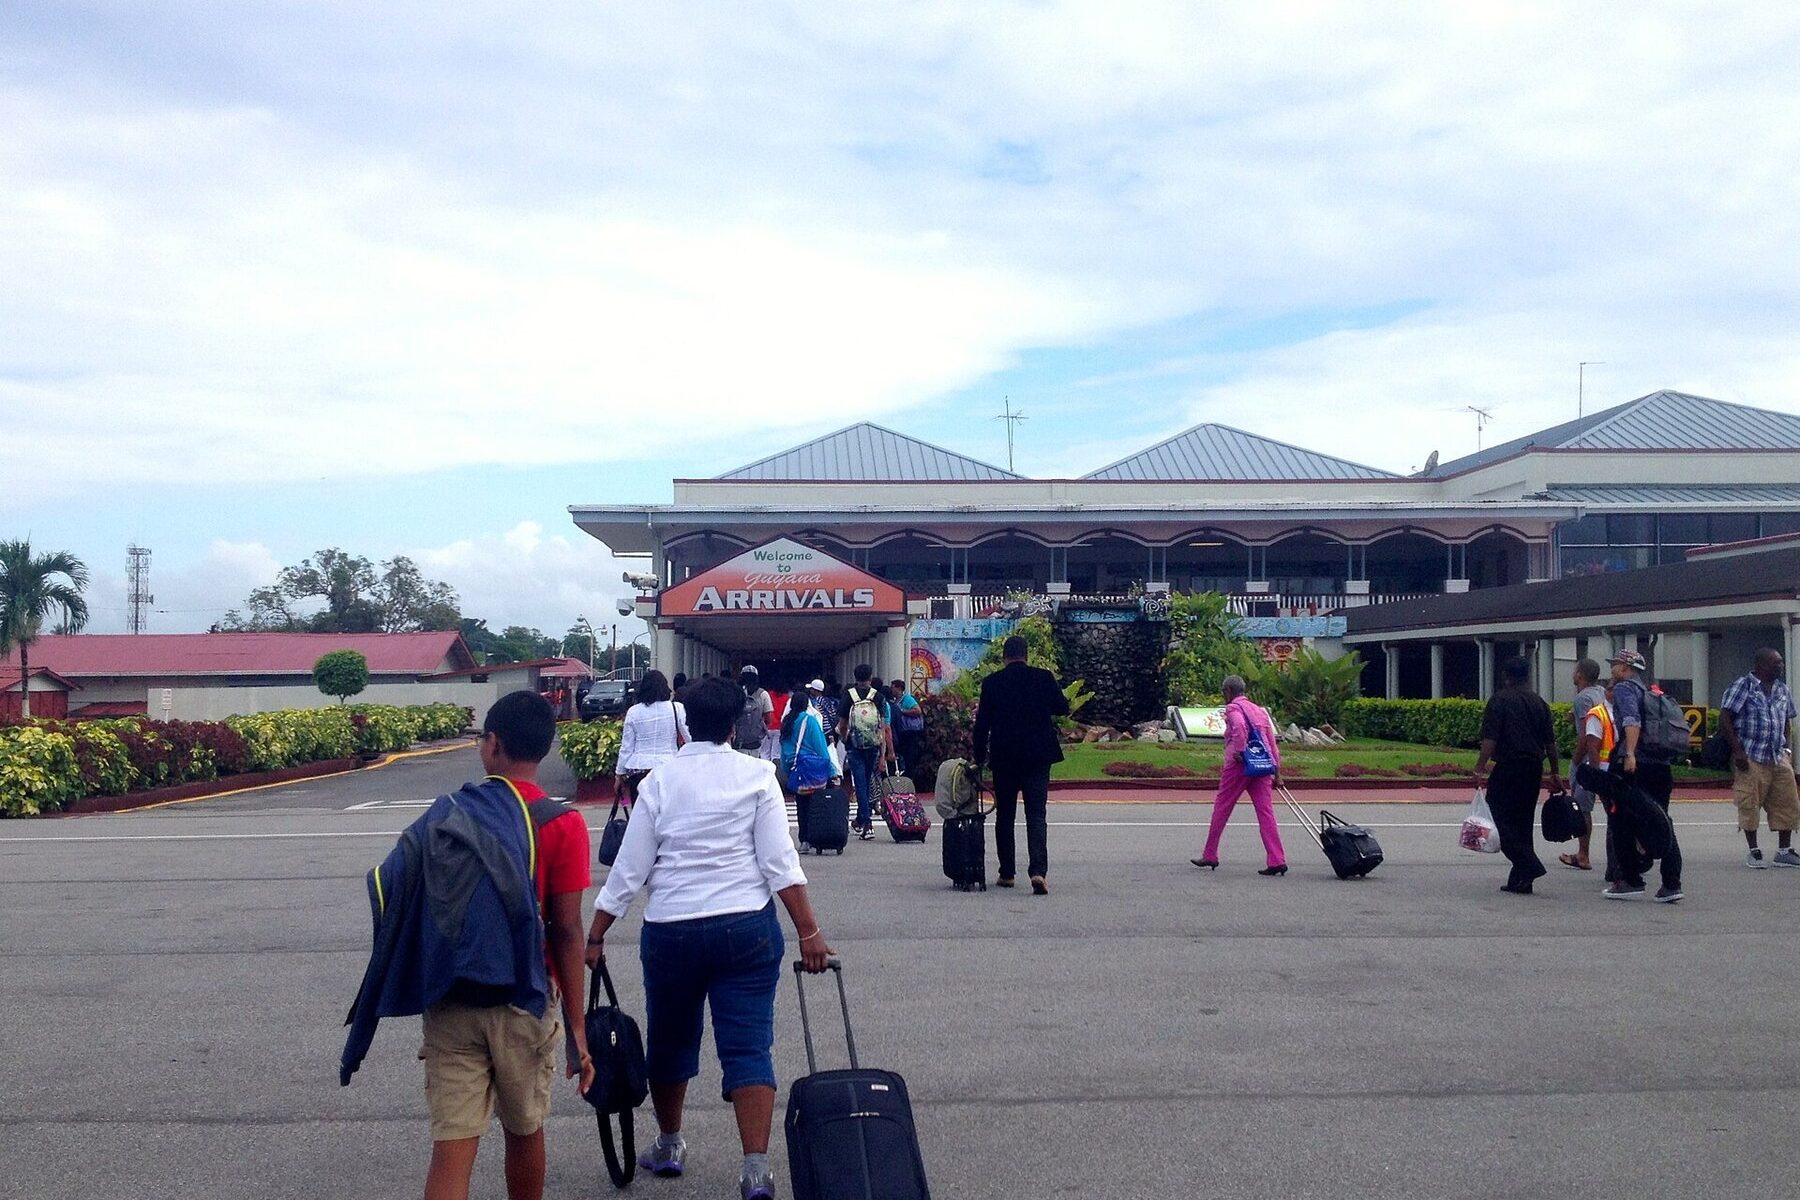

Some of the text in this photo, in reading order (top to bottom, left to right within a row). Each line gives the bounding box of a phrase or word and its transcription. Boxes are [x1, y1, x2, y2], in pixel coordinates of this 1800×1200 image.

[753, 550, 813, 561] Welcome
[777, 563, 792, 573] to
[743, 572, 823, 589] Guyana
[692, 586, 875, 611] ARRIVALS
